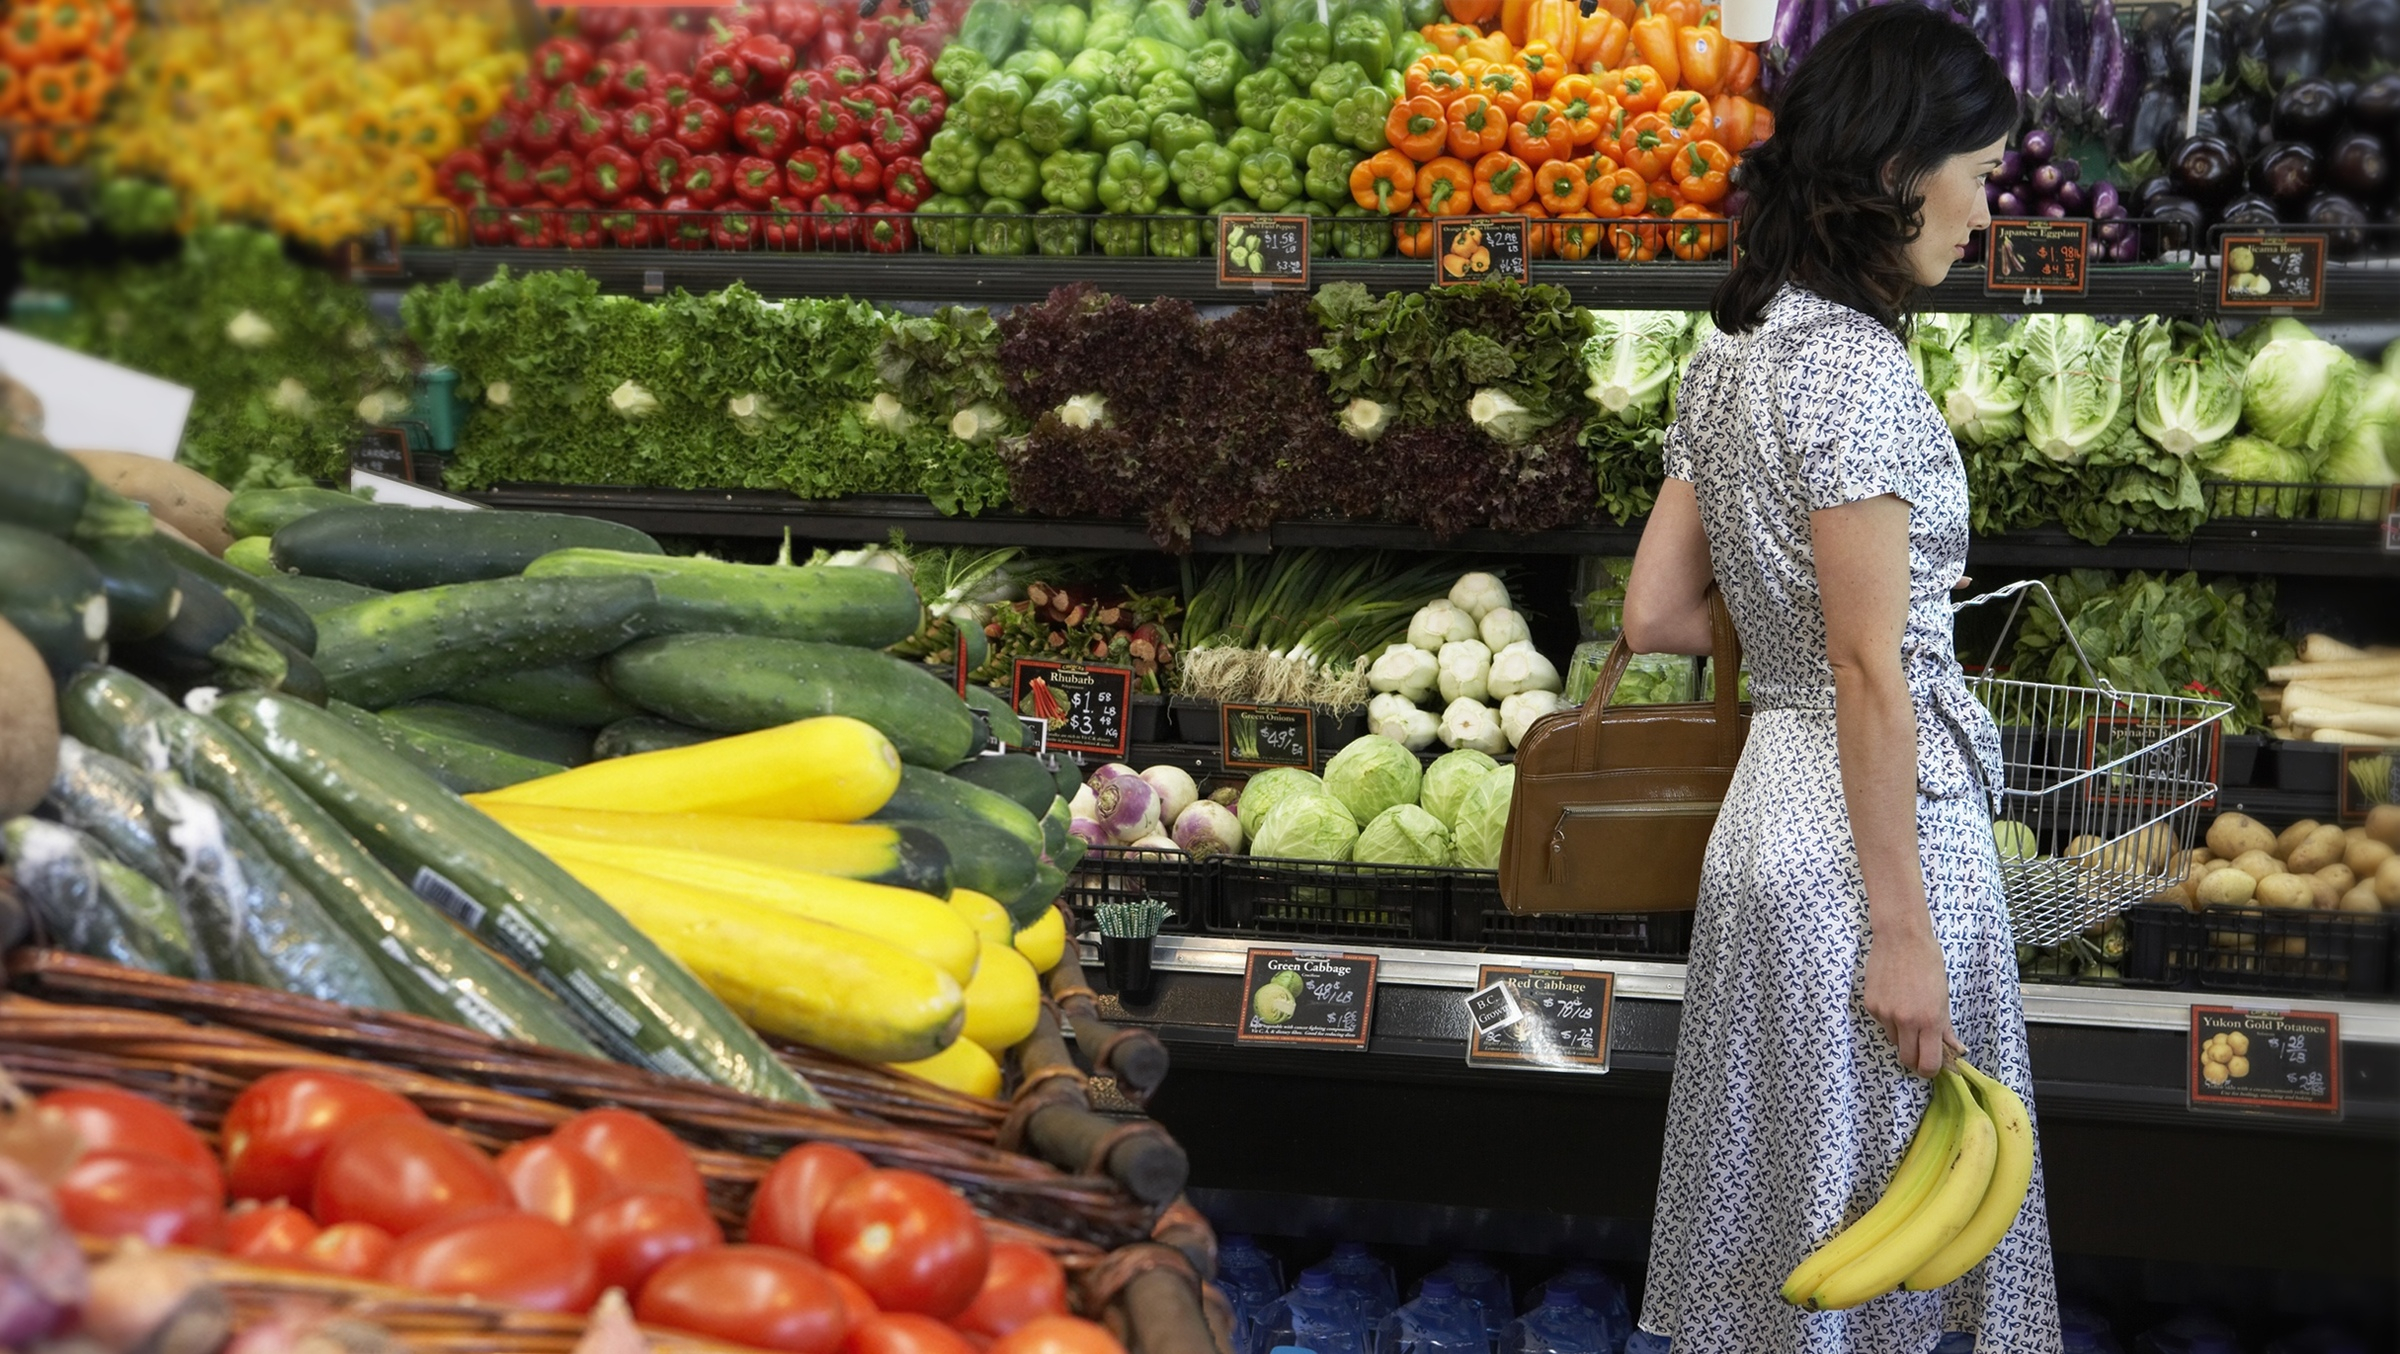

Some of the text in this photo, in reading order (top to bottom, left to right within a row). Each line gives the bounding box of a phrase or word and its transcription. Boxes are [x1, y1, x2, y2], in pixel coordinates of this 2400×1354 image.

[1276, 223, 1297, 231] Peppers
[1999, 227, 2080, 239] Japanese Eggplant
[2248, 244, 2302, 253] Jicama Root
[1050, 671, 1095, 685] Rhubarb
[1103, 706, 1117, 717] LB
[1240, 711, 1296, 722] Green Onions
[1268, 959, 1352, 977] Green Cabbage
[1508, 977, 1586, 993] Red Cabbage
[1477, 994, 1499, 1010] B.C.
[1479, 1004, 1511, 1023] Grown
[2203, 1016, 2242, 1028] Yukon
[2244, 1019, 2273, 1030] Gold
[2276, 1021, 2326, 1033] Potatoes
